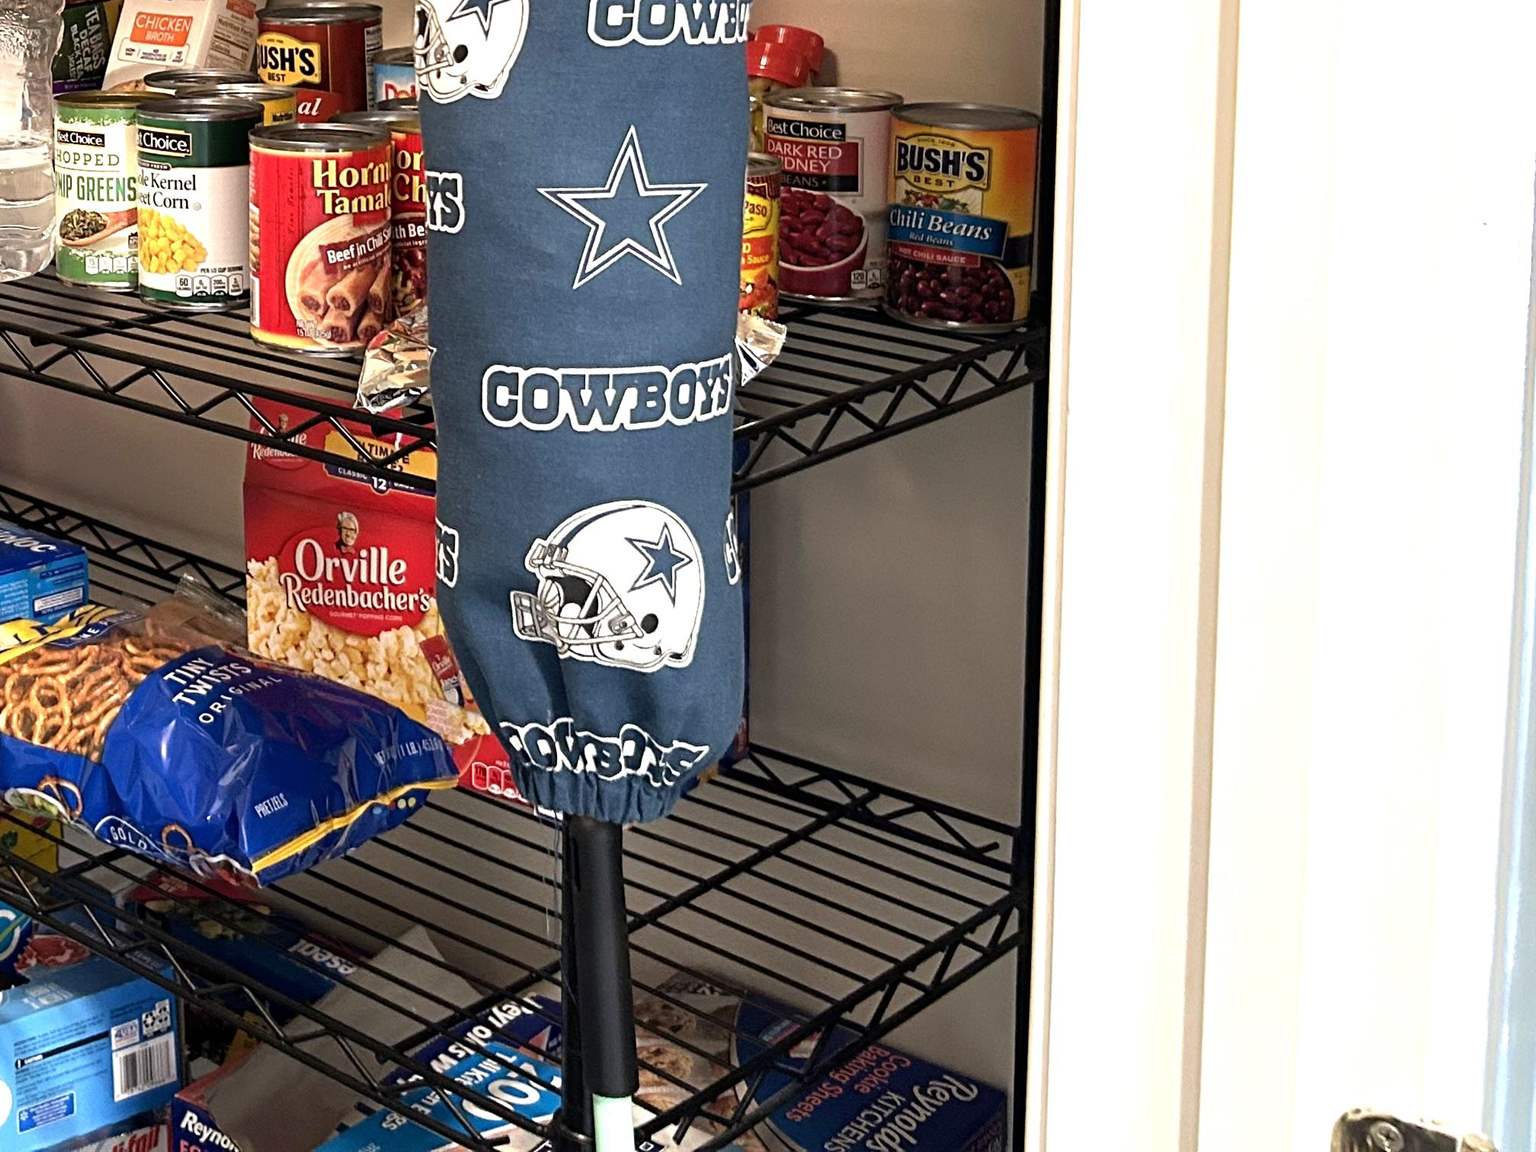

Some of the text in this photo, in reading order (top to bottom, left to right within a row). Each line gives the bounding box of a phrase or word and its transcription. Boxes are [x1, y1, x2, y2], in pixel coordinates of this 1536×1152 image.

[135, 14, 192, 31] CHICKEN
[144, 30, 175, 42] BROTH
[70, 23, 80, 58] BLACK
[79, 29, 94, 72] DECAF
[89, 34, 106, 70] BAGS
[257, 44, 315, 76] USH'S
[267, 72, 286, 83] BEST
[69, 132, 103, 146] Choice
[767, 119, 842, 140] Best Choice
[767, 140, 842, 160] DARK RED
[896, 138, 986, 182] BUSH'S
[76, 175, 138, 203] GREENS
[151, 172, 197, 191] Kernel
[912, 174, 956, 189] BEST
[153, 191, 189, 210] Corn
[317, 184, 391, 215] Tamal
[888, 206, 993, 241] Chili Beans
[908, 231, 955, 247] Red Beans
[327, 234, 383, 265] Beef in Chili
[913, 249, 967, 265] CHILI SAUCE
[179, 277, 189, 287] 60
[481, 352, 733, 433] COWBOYS
[372, 476, 387, 490] 12
[295, 538, 407, 585] Orville
[280, 572, 431, 612] Redenbacher's
[163, 657, 214, 685] TINY
[172, 662, 252, 706] TWISTS
[198, 675, 283, 724] ORIGINAL
[254, 792, 289, 819] PRETZELS
[785, 1044, 892, 1122] Baking Sheets
[854, 1054, 912, 1095] Cookie
[824, 1090, 905, 1152] KITCHENS
[866, 1074, 979, 1152] Reynolds
